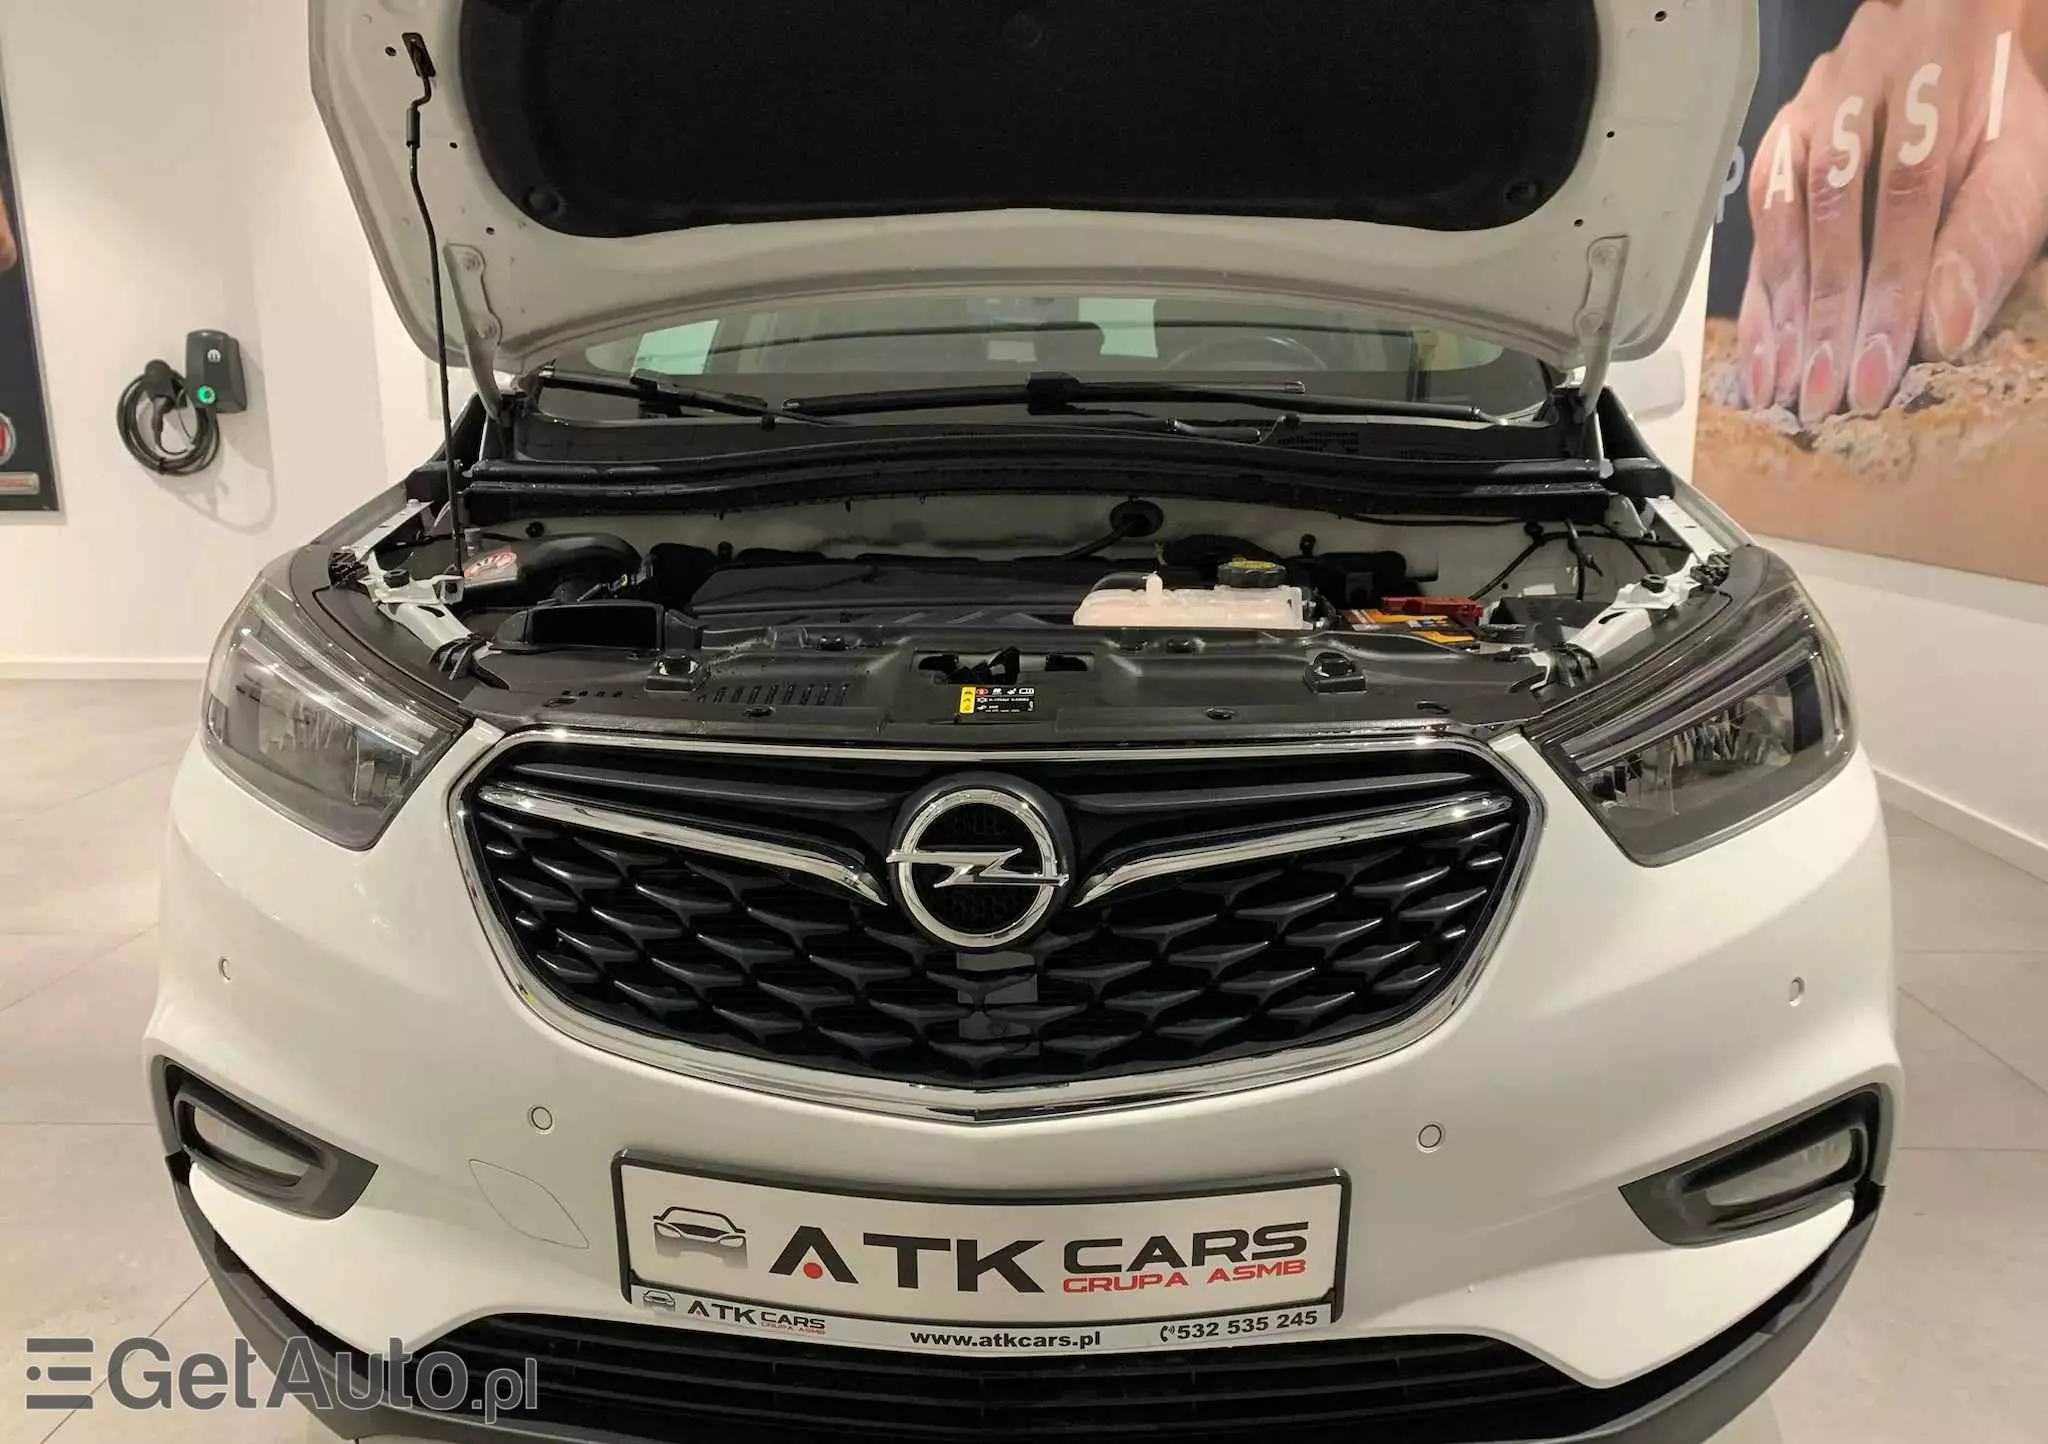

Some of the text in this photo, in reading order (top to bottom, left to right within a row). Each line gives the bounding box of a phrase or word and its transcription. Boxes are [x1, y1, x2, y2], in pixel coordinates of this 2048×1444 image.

[769, 1221, 1309, 1293] ATK CARS
[1063, 1258, 1306, 1293] GRUPA ASMB
[687, 1300, 825, 1329] ATK CARS
[1177, 1310, 1318, 1339] 532 535 245
[910, 1331, 1101, 1349] www.atkcars.pl
